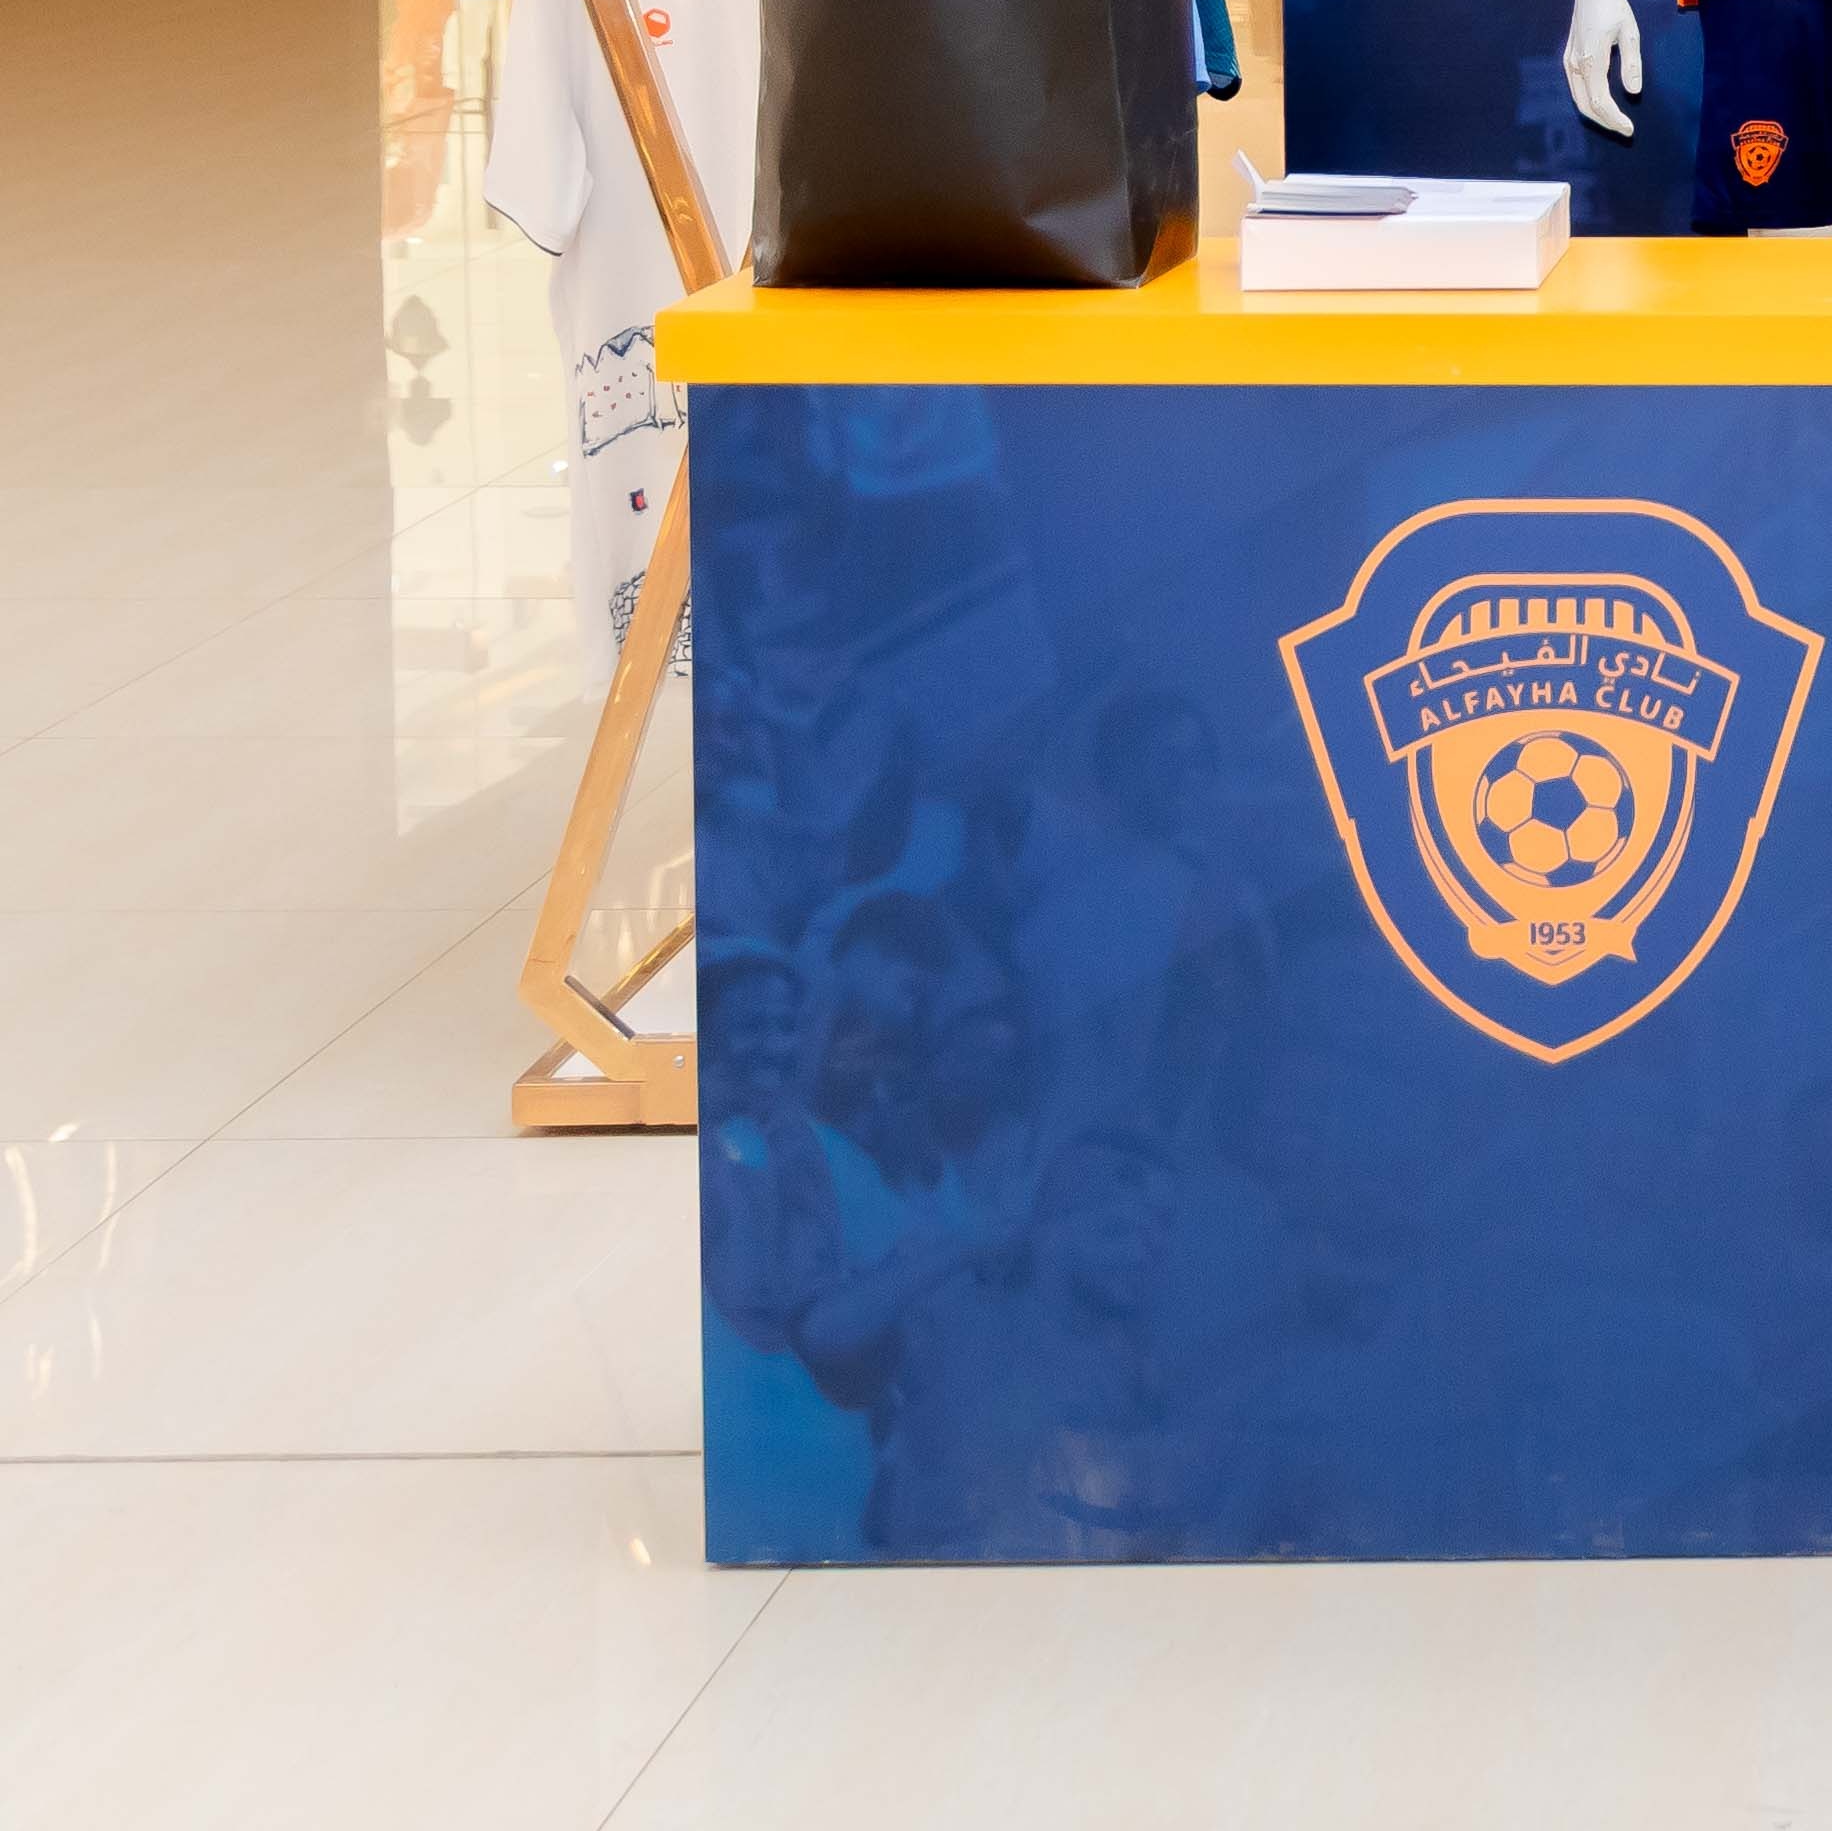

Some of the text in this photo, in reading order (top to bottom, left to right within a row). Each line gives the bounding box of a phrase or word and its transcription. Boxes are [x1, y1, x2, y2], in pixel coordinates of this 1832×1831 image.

[1409, 634, 1702, 698] نادي الفيحاء
[1418, 680, 1687, 732] ALFAYHA CLUB
[1528, 921, 1587, 946] 1953
